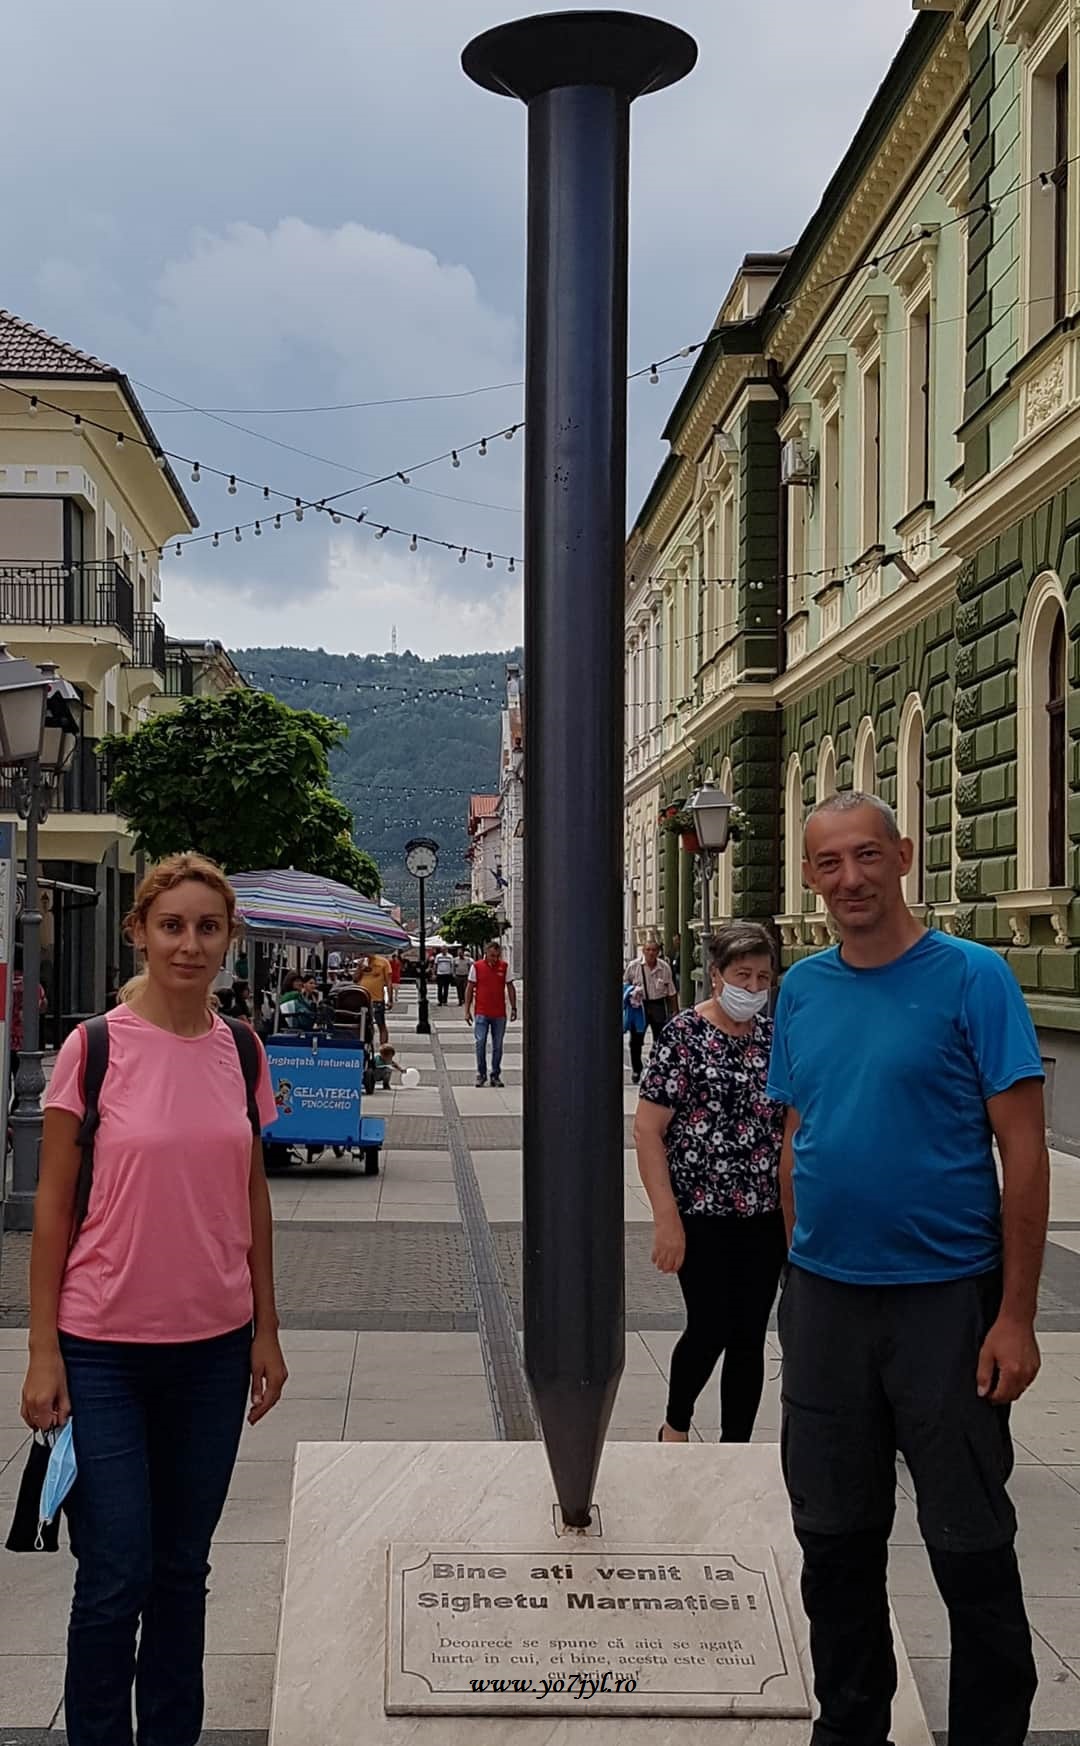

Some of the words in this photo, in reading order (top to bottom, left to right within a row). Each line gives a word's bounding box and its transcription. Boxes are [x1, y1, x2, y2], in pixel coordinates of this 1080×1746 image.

[293, 1086, 360, 1100] GELATERIA
[301, 1100, 352, 1111] PINOCCHIO
[432, 1563, 507, 1579] Bine
[596, 1565, 682, 1581] venit
[703, 1565, 735, 1581] la
[417, 1592, 549, 1612] Sighetu
[439, 1637, 513, 1648] Deoarece
[522, 1639, 539, 1648] se
[549, 1639, 598, 1650] spune
[607, 1638, 625, 1649] că
[635, 1638, 663, 1649] aici
[673, 1640, 690, 1649] se
[510, 1653, 540, 1666] cui,
[550, 1653, 564, 1664] ei
[570, 1653, 611, 1666] bine,
[618, 1654, 668, 1665] acesta
[674, 1655, 706, 1665] este
[716, 1654, 756, 1666] cuiul
